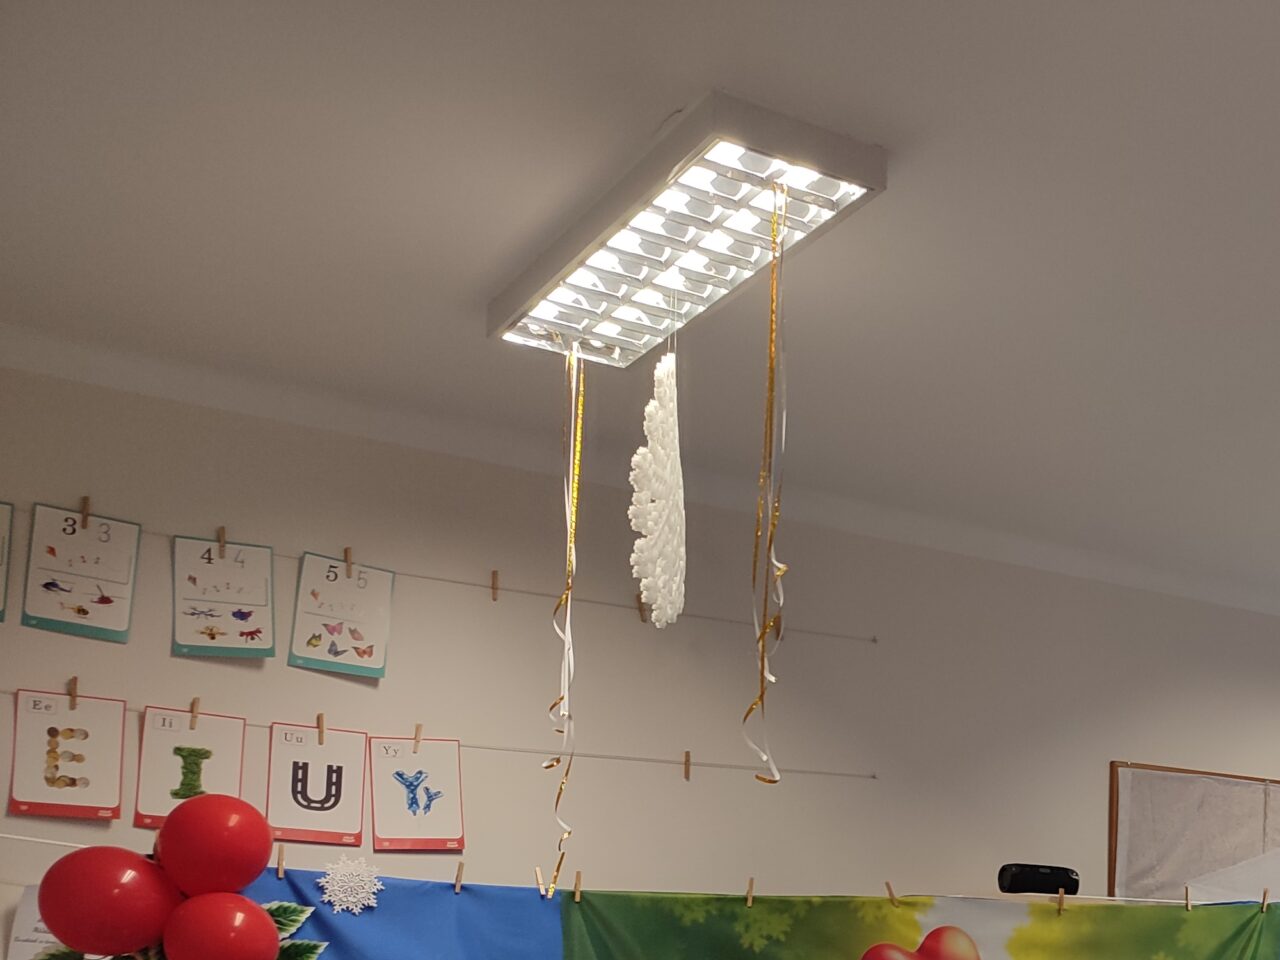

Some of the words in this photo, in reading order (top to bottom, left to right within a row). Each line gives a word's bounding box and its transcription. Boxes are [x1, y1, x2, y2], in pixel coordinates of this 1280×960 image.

[62, 517, 77, 536] 3
[200, 548, 214, 565] 4
[326, 565, 339, 582] 5
[291, 760, 343, 812] U
